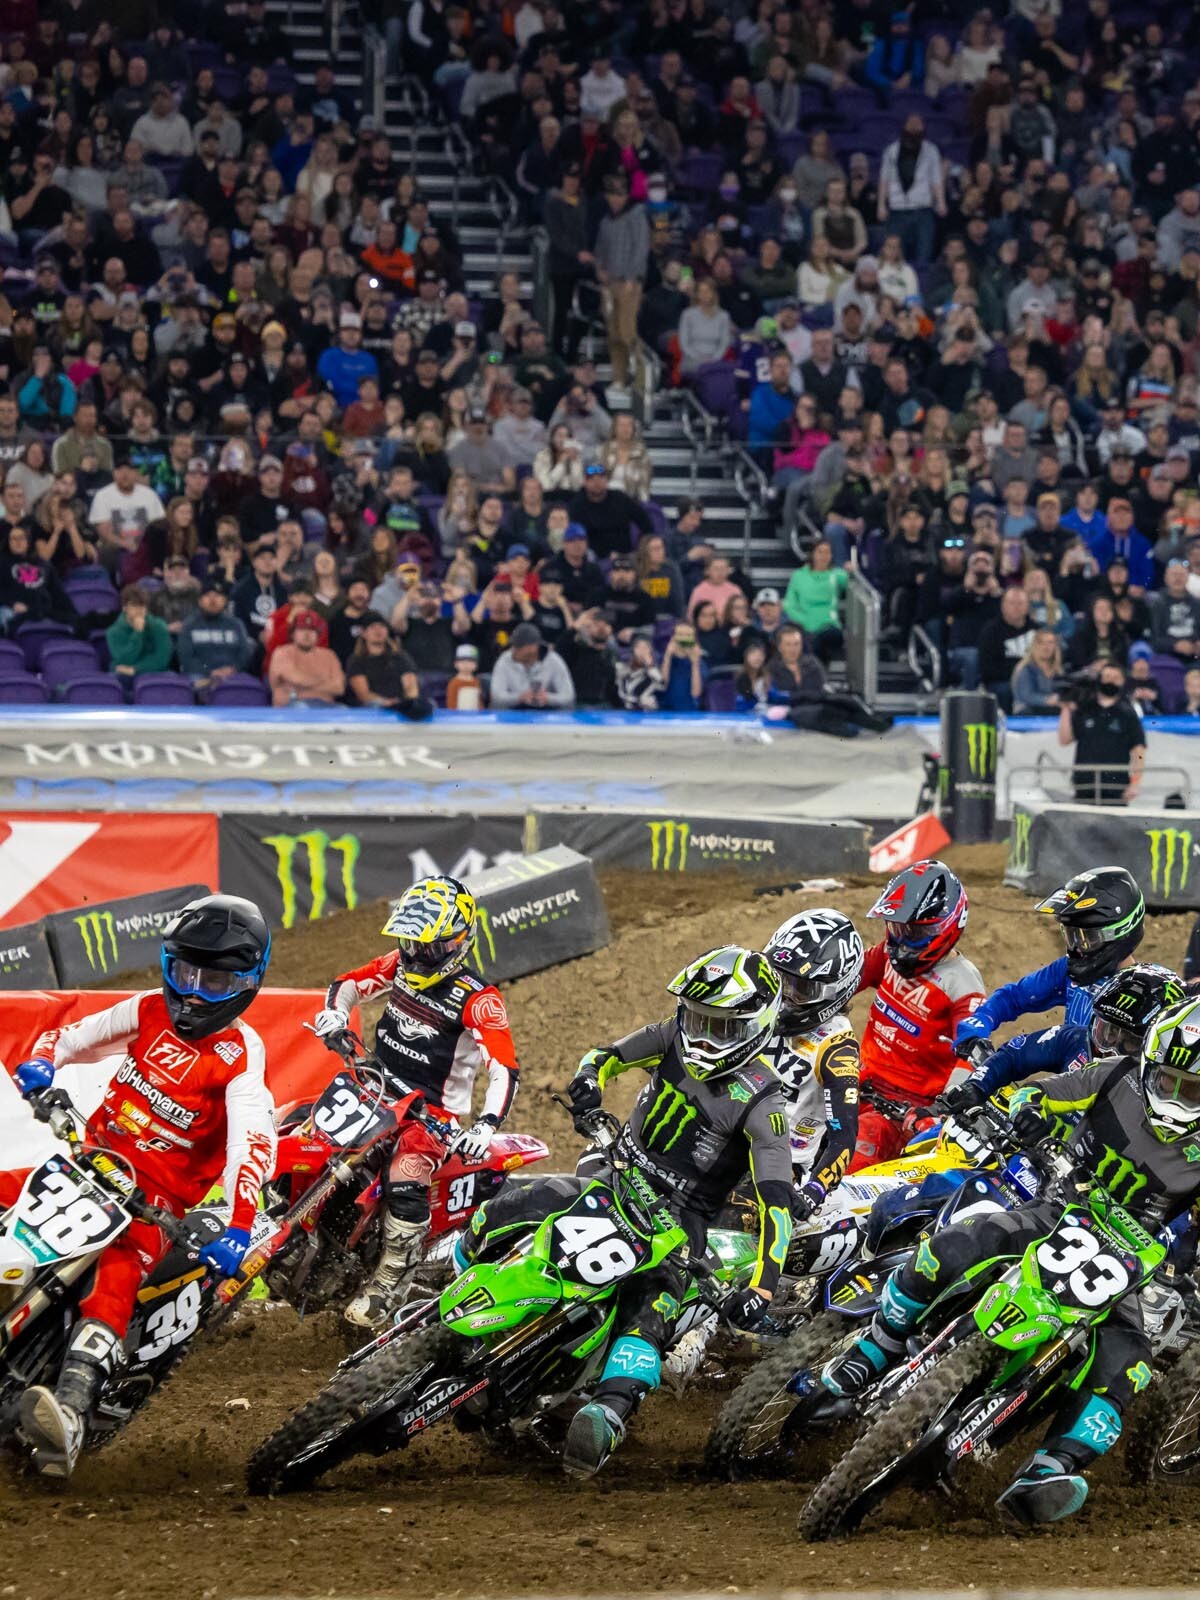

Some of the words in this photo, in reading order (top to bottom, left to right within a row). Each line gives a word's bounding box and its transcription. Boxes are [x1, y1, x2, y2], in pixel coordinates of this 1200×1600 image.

[22, 741, 448, 769] MONSTER
[690, 834, 776, 854] MONSTER
[492, 888, 580, 928] MONSTER
[708, 966, 725, 975] BELL
[886, 1006, 920, 1037] UNLIMITED
[150, 1041, 192, 1070] FLY
[382, 1034, 430, 1064] HONDA
[126, 1068, 196, 1124] Husqvarna
[314, 1088, 380, 1146] 37
[18, 1170, 112, 1255] 38
[446, 1173, 475, 1213] 37
[219, 1236, 246, 1254] FLY
[554, 1215, 637, 1285] 48
[808, 1229, 860, 1273] 81
[1037, 1226, 1129, 1306] 33
[137, 1279, 202, 1362] 38
